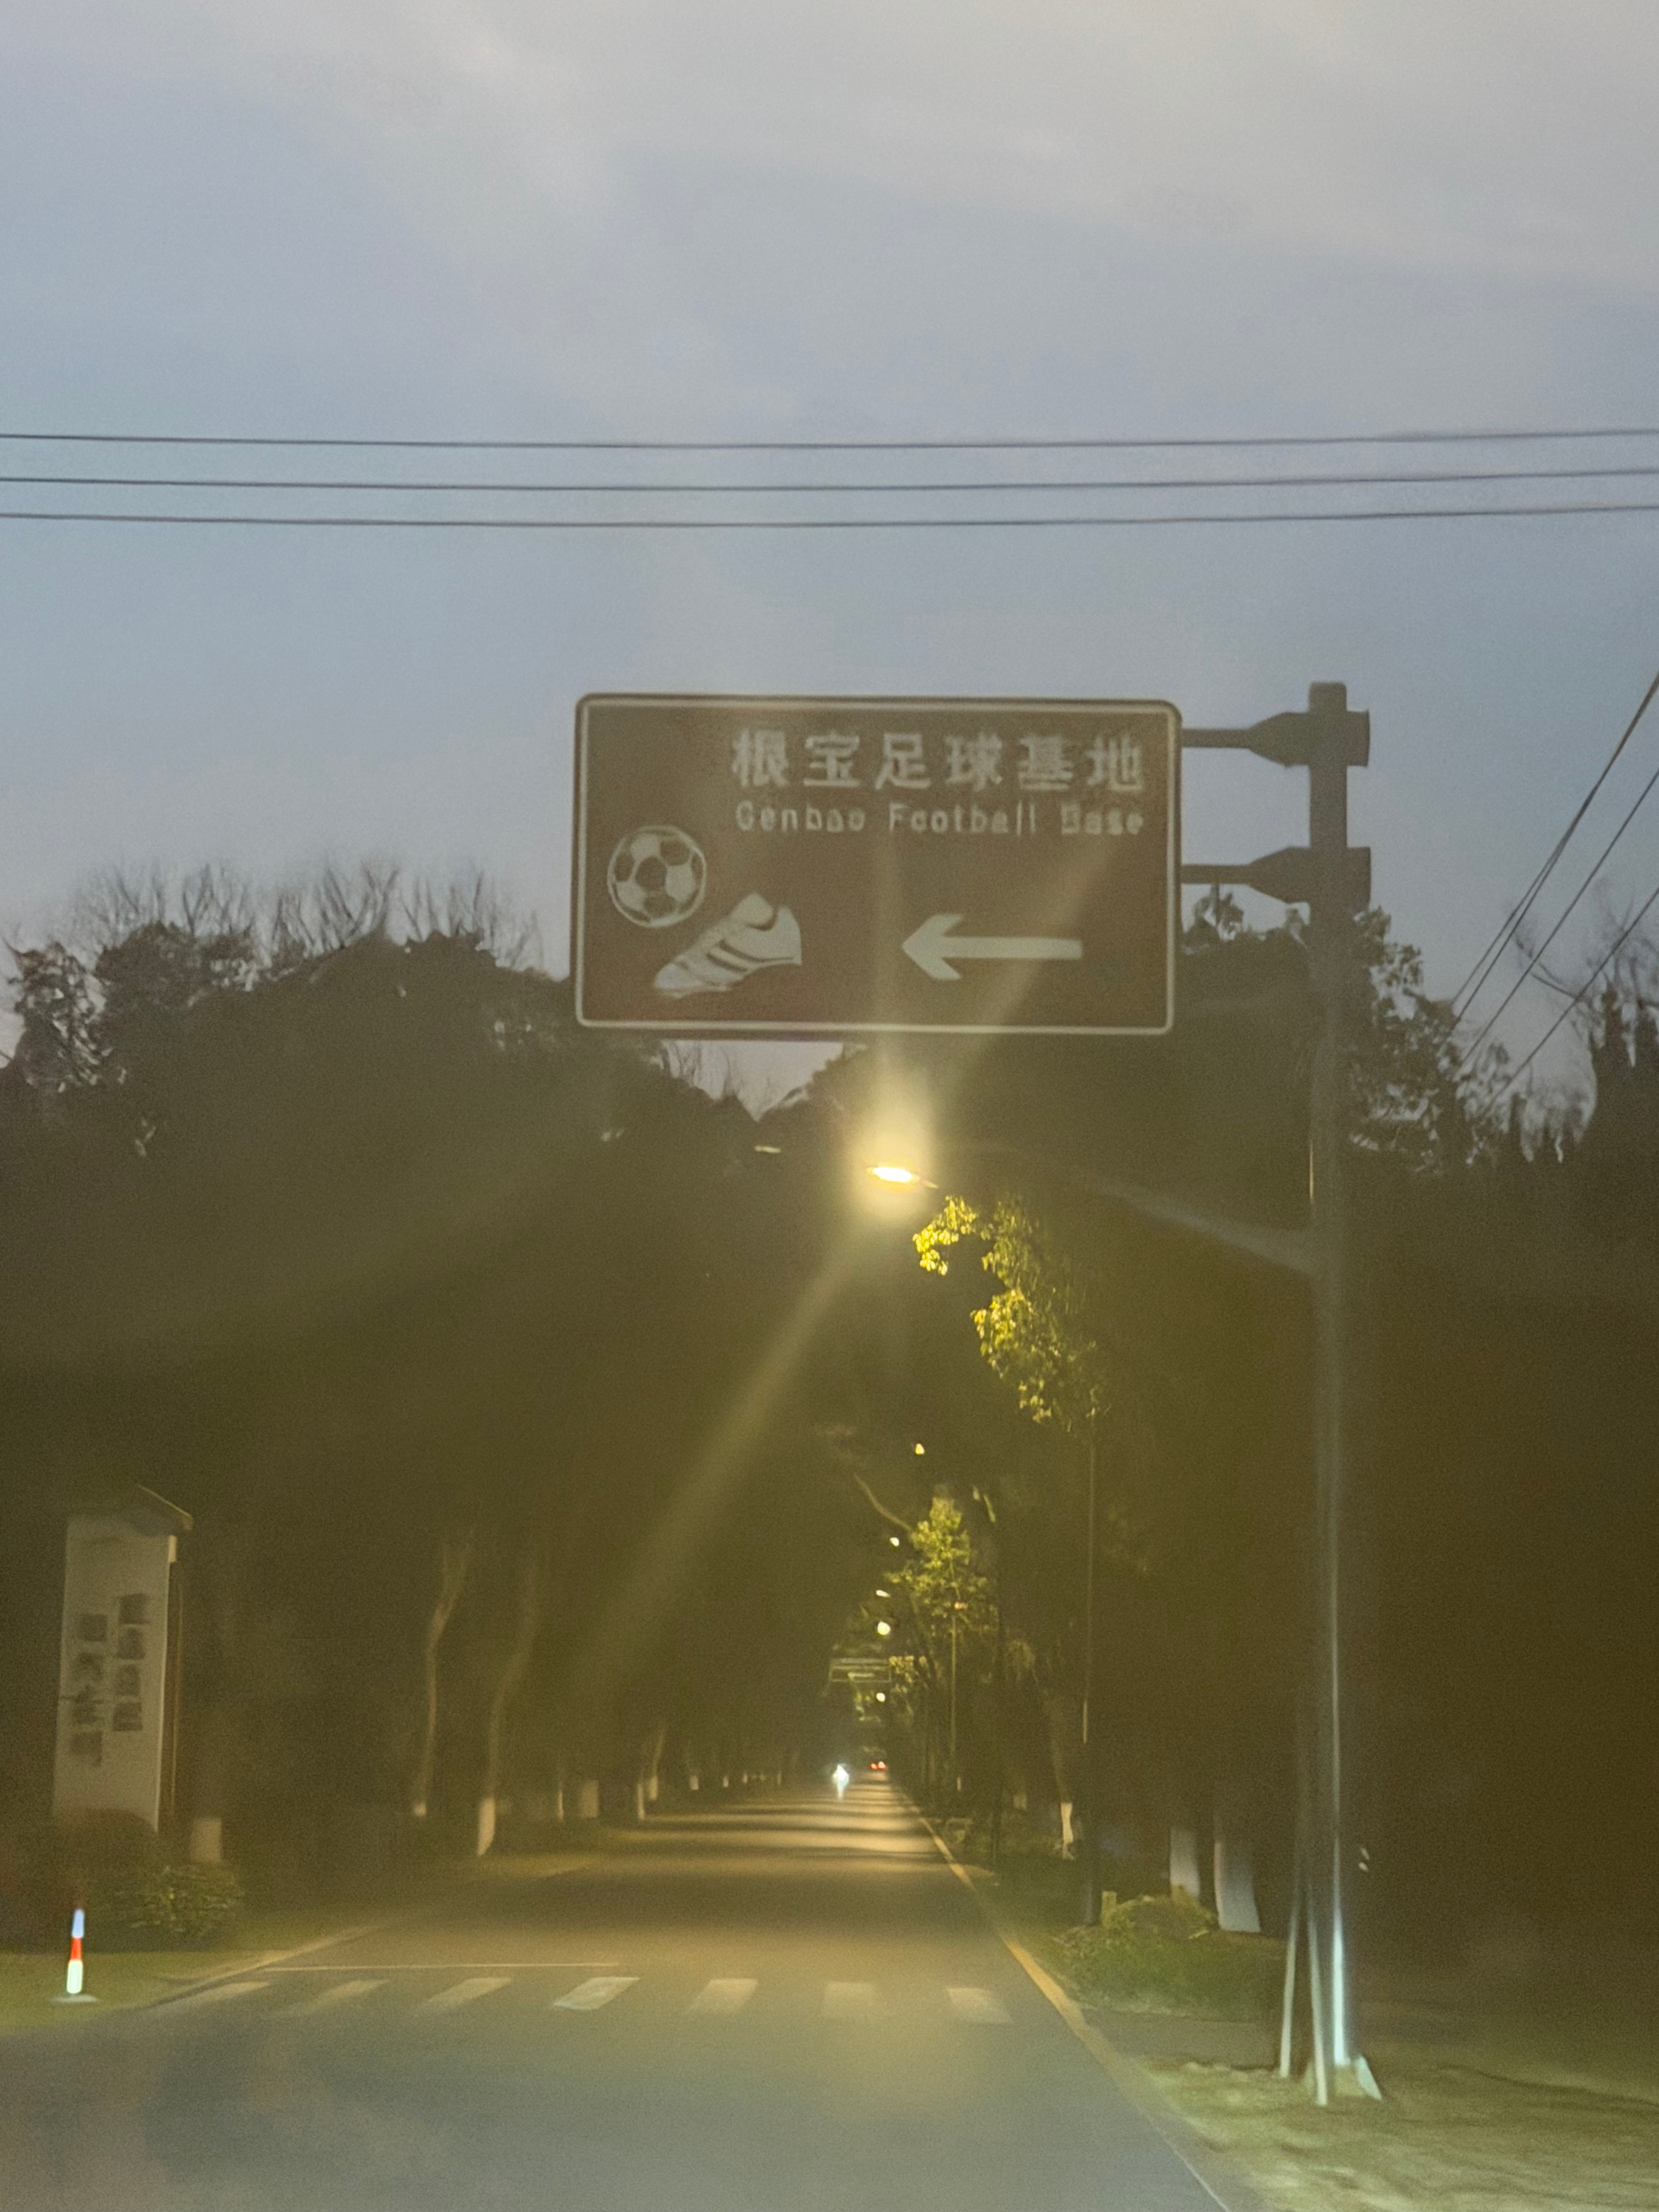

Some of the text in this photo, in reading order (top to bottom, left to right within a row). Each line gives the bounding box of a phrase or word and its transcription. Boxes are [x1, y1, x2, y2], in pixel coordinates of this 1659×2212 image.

[732, 729, 1143, 791] 根宝足球基地
[736, 800, 866, 833] Genbao
[889, 801, 1036, 836] Football
